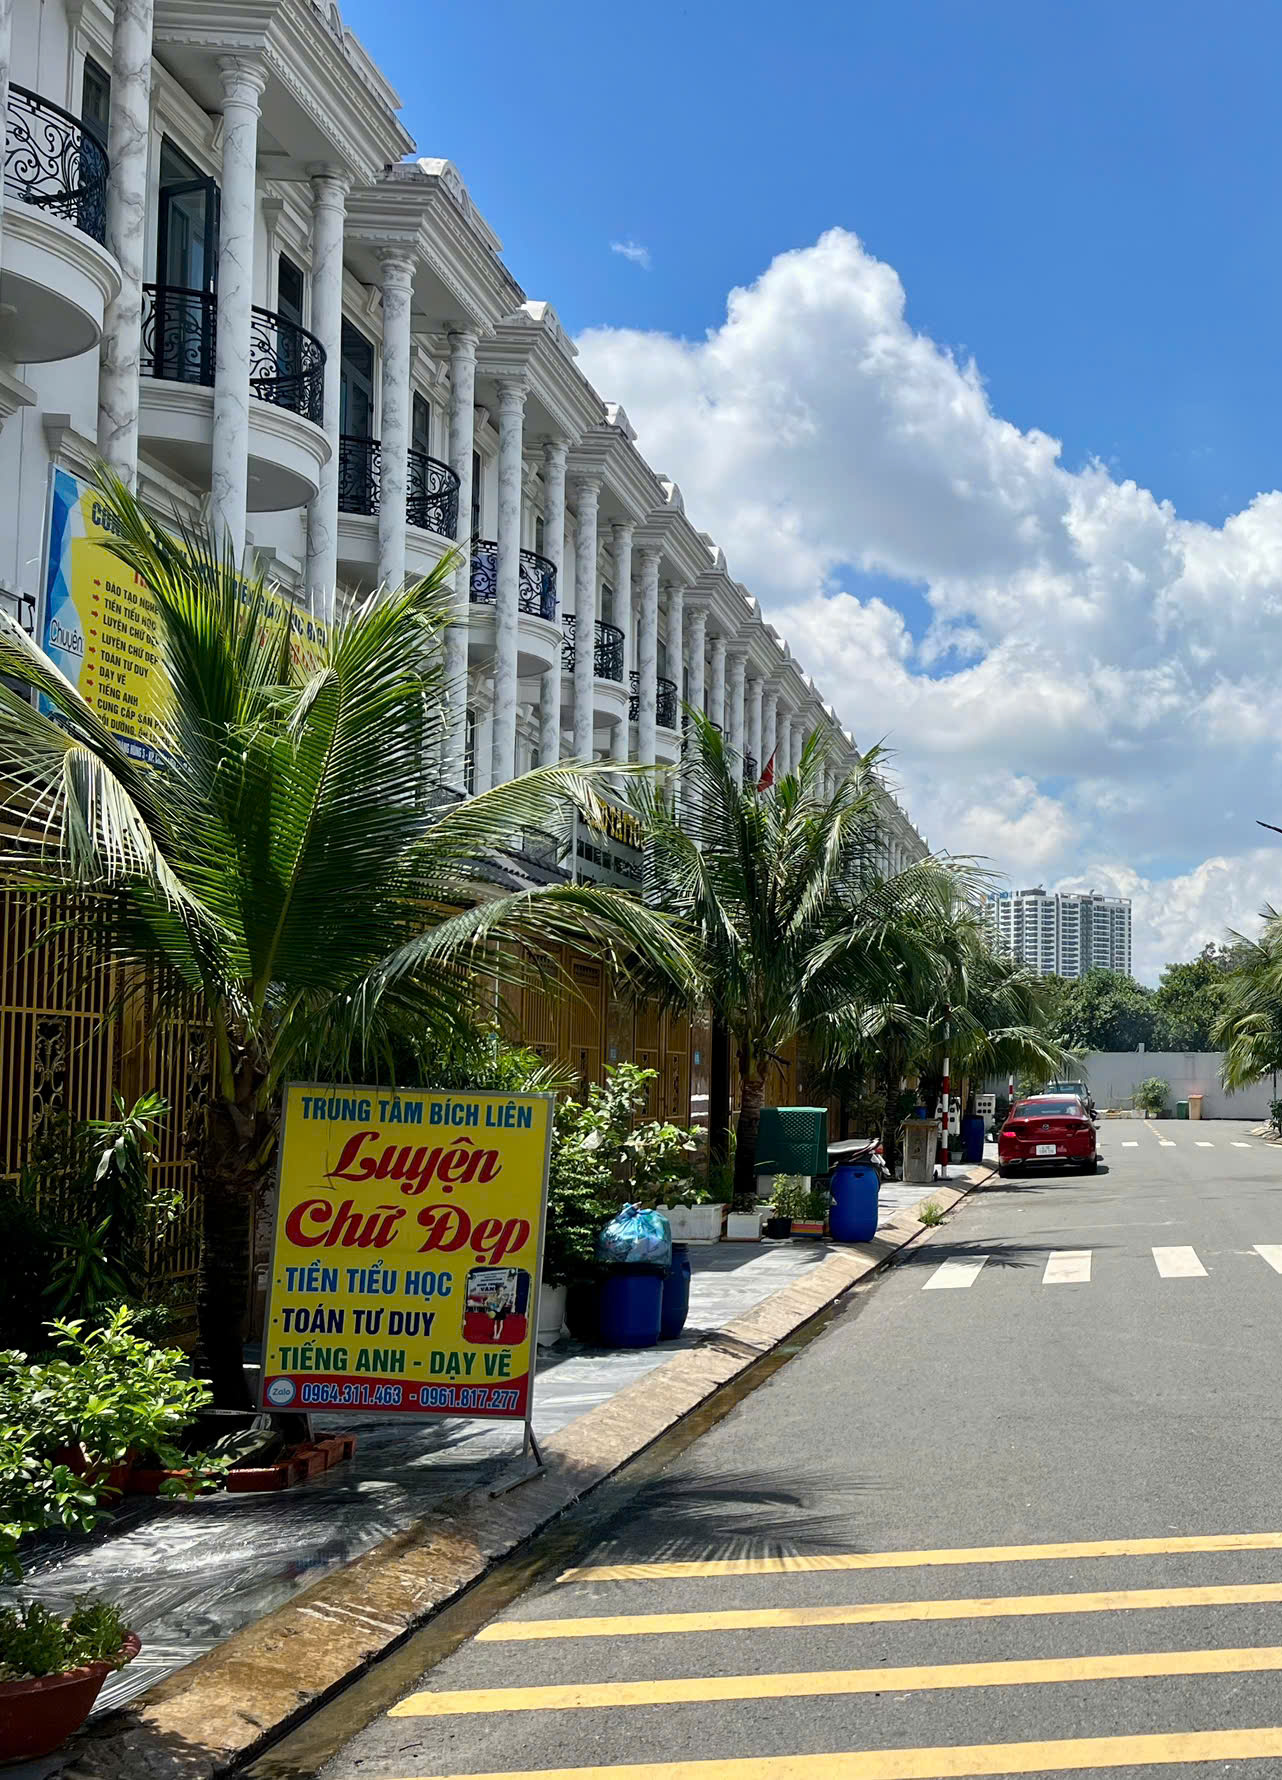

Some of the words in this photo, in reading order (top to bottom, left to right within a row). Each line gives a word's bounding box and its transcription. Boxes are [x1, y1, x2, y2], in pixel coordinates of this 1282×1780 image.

[122, 691, 138, 707] ANH
[302, 1097, 371, 1122] TRUNG
[379, 1096, 423, 1125] TÂM
[430, 1099, 479, 1127] BÍCH
[485, 1101, 533, 1128] LIÊN
[325, 1131, 502, 1195] Luyện
[285, 1199, 407, 1249] Chữ
[417, 1204, 530, 1265] Đẹp
[286, 1259, 339, 1293] TIỀN
[346, 1259, 397, 1295] TIỂU
[405, 1270, 453, 1302] HỌC
[281, 1304, 345, 1334] TOÁN
[352, 1307, 385, 1335] TƯ
[388, 1311, 436, 1337] DUY
[279, 1340, 348, 1372] TIẾNG
[355, 1348, 406, 1373] ANH
[430, 1351, 476, 1380] DẠY
[484, 1349, 512, 1377] VẼ
[272, 1388, 291, 1396] Zalo
[302, 1383, 403, 1405] 0964.311.463
[420, 1386, 520, 1410] 0961.817.277
